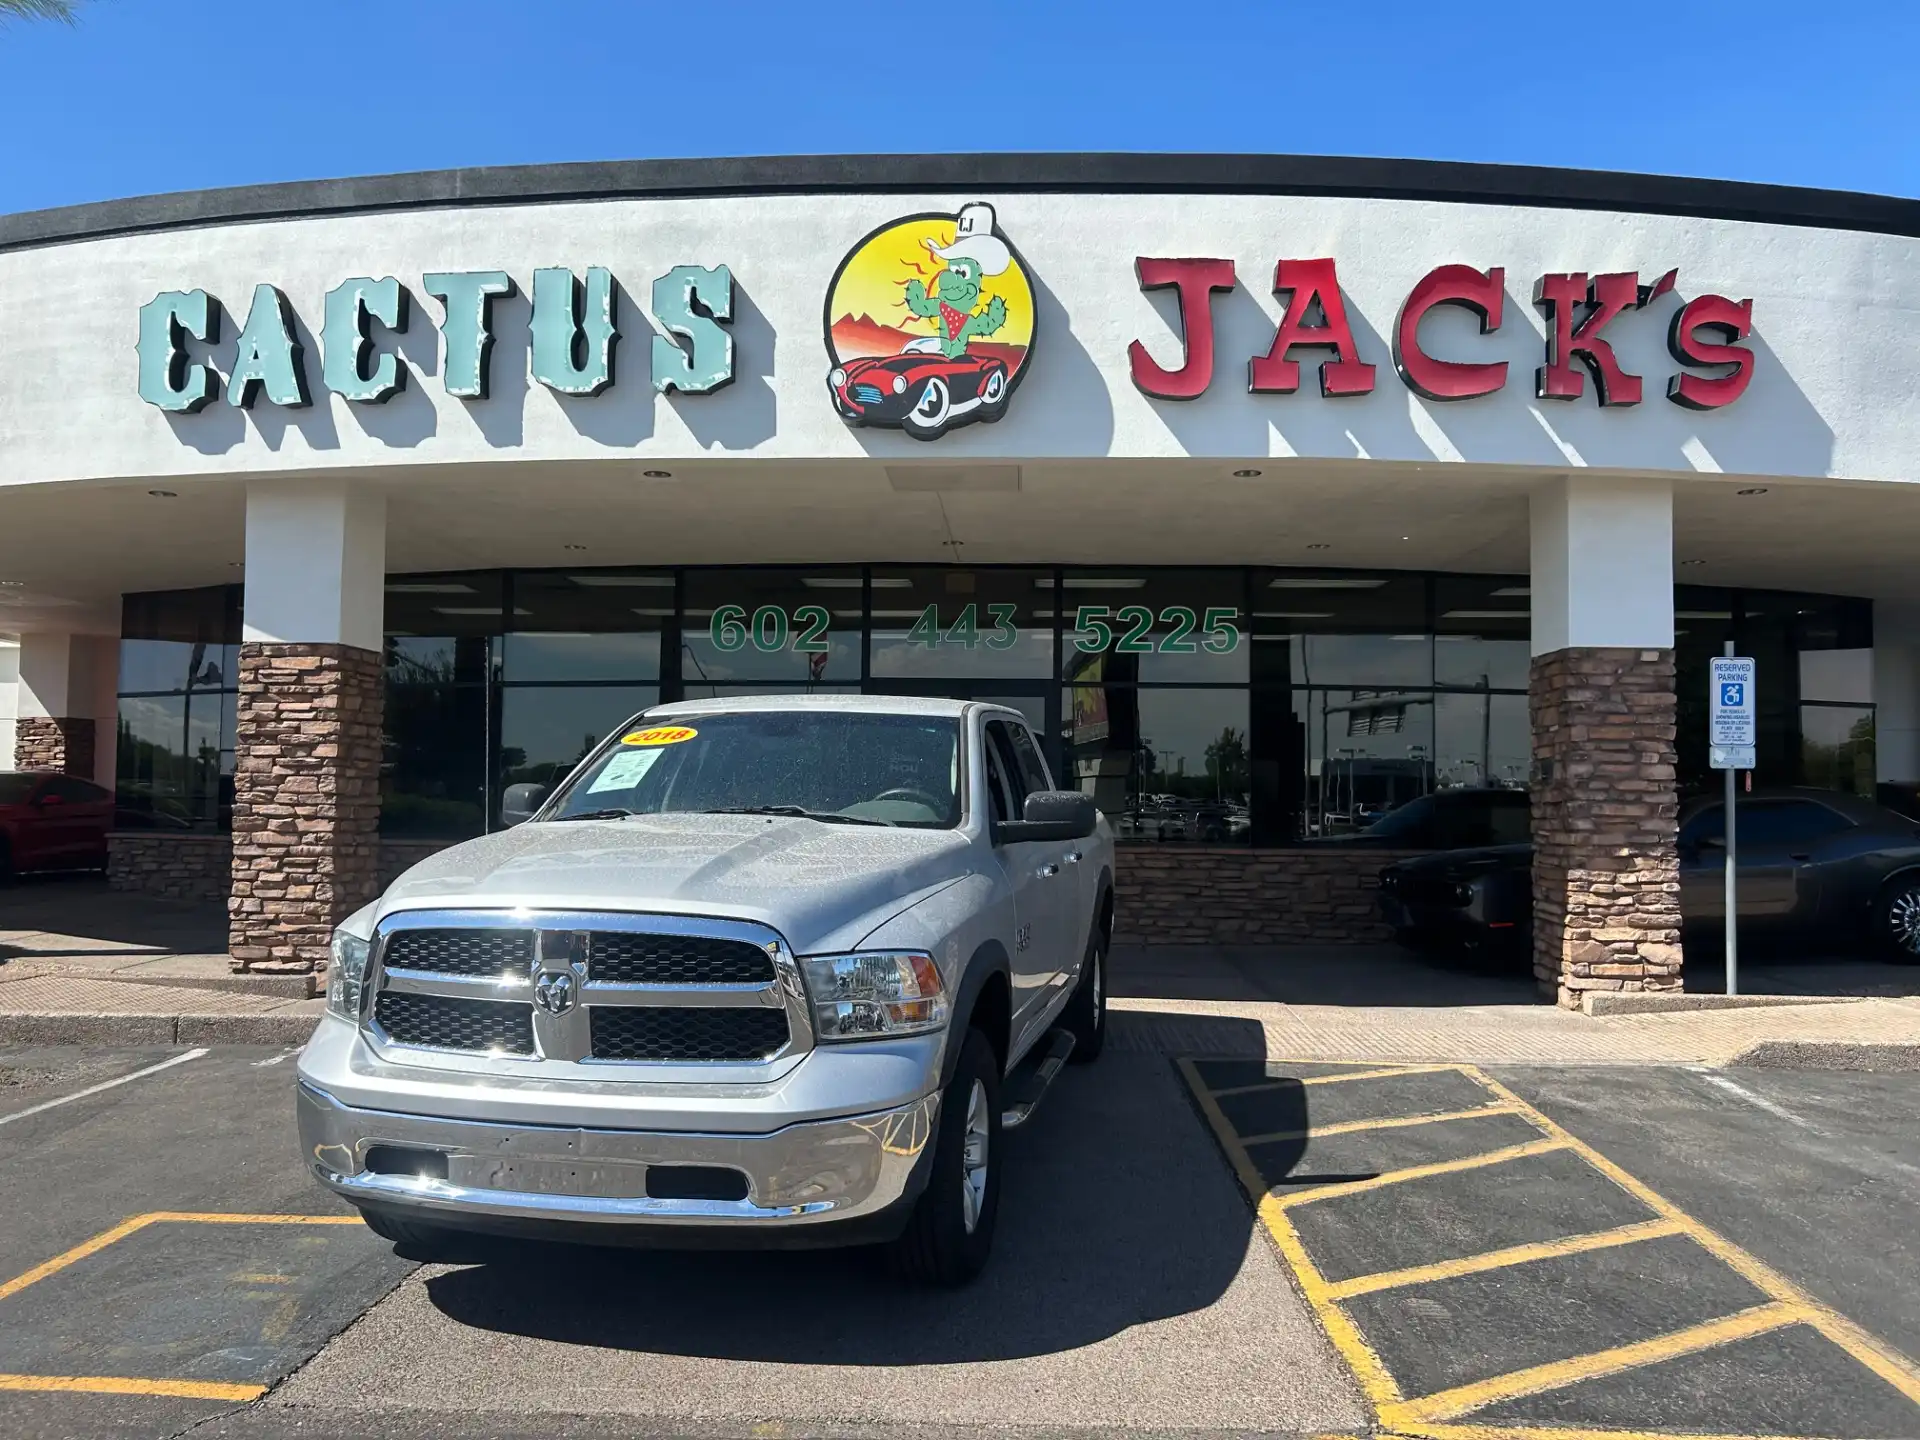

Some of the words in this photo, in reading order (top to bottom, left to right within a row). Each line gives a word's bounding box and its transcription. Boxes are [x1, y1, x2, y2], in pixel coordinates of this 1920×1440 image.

[959, 217, 974, 232] CJ
[135, 264, 736, 413] CACTUS
[709, 604, 831, 653] 602
[906, 603, 1018, 651] 443
[1072, 605, 1240, 655] 5225
[1714, 664, 1751, 672] RESERVED
[1718, 673, 1748, 682] PARKING
[628, 730, 689, 742] 2018
